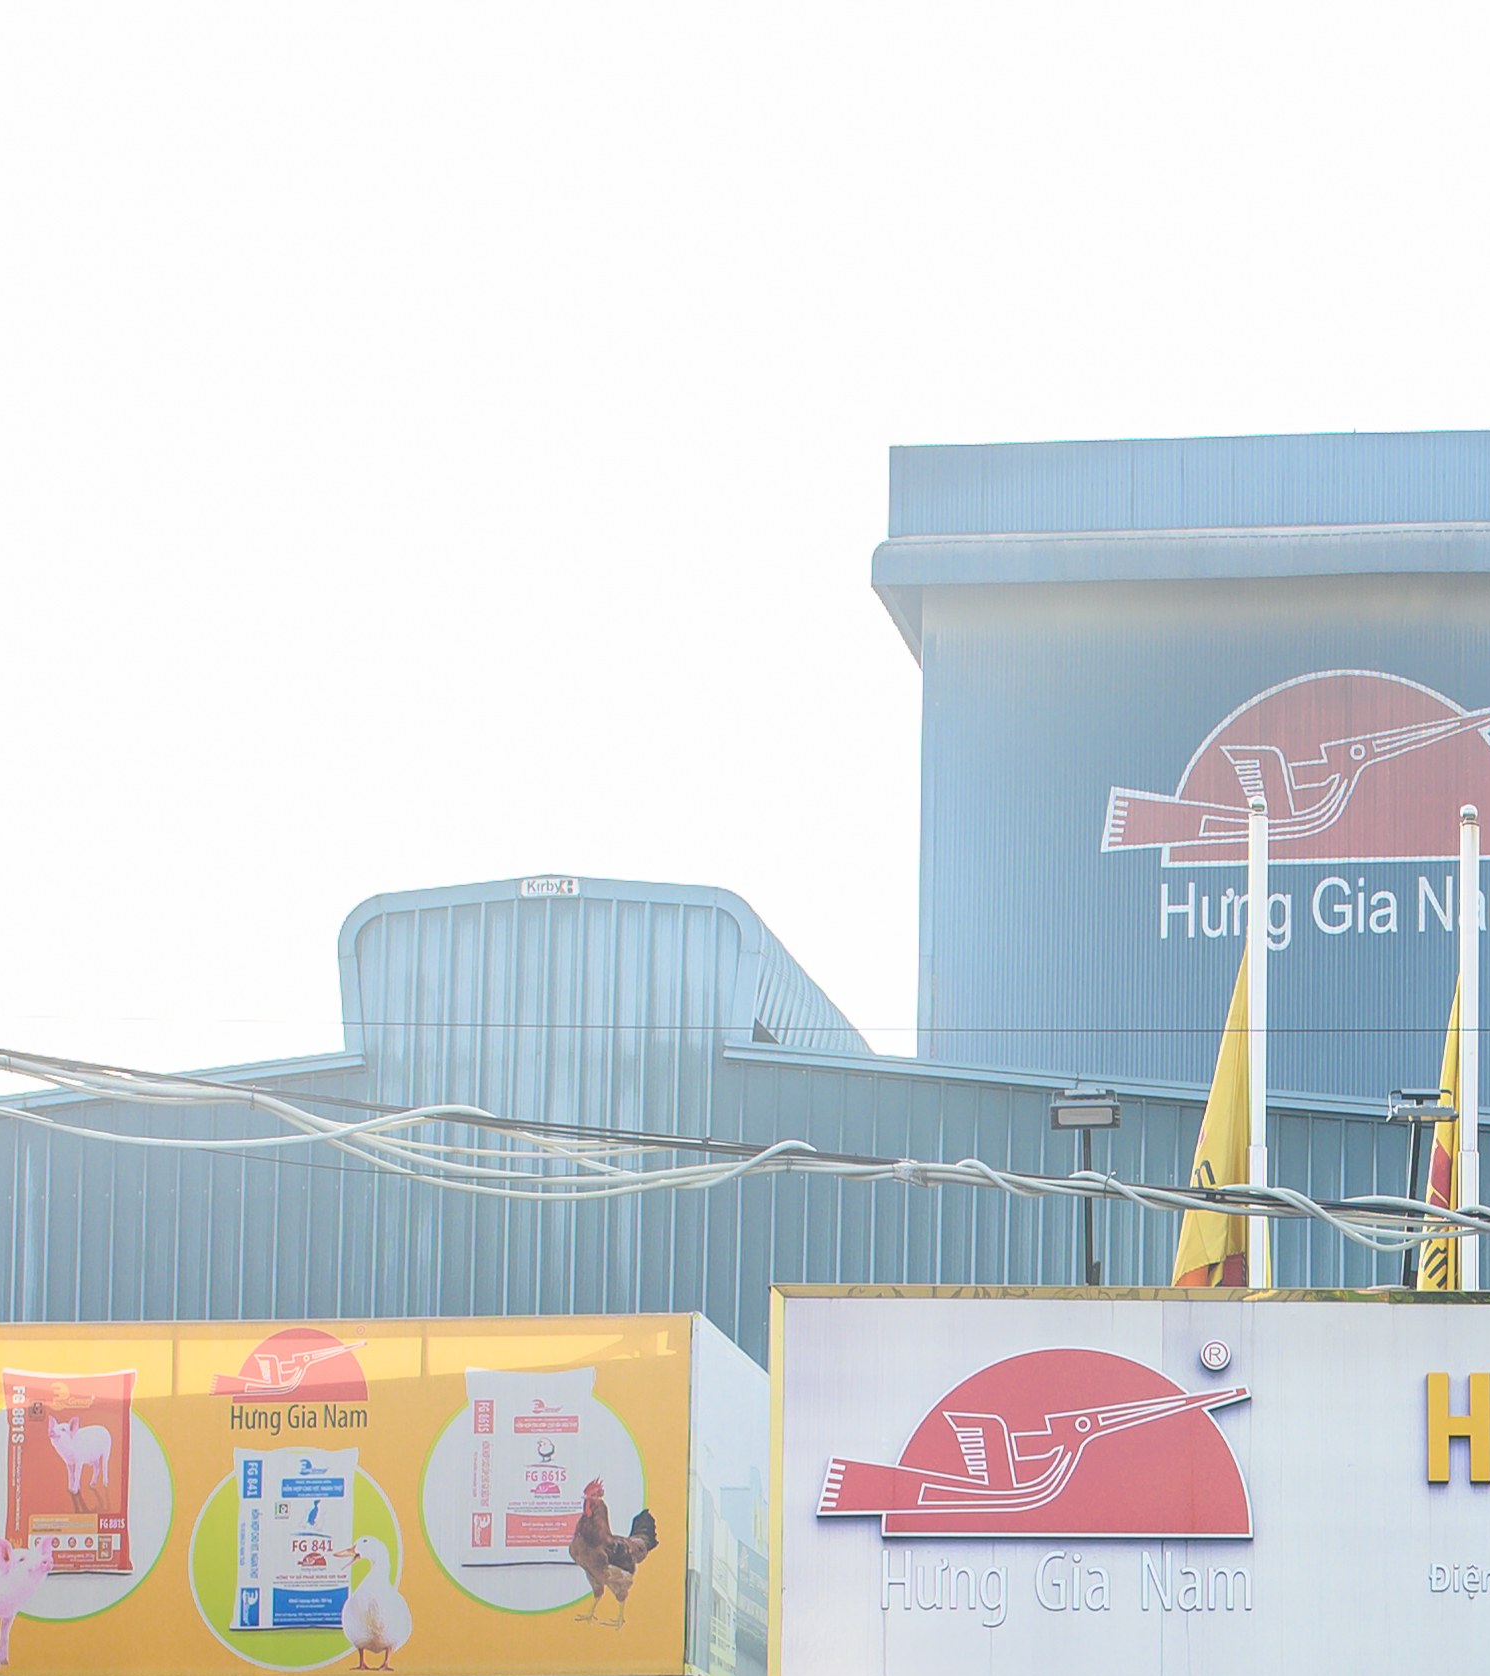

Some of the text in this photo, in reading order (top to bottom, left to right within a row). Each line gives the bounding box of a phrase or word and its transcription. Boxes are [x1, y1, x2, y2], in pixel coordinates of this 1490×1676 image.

[1160, 881, 1292, 951] Hưng
[1313, 876, 1397, 934] Gia
[12, 1385, 25, 1405] FG
[478, 1402, 490, 1414] FG
[12, 1408, 25, 1444] 881S
[230, 1404, 368, 1436] Hưng Gia Nam
[247, 1462, 258, 1496] FG 841
[525, 1470, 567, 1481] FG 861S
[292, 1540, 333, 1552] FG 841
[881, 1551, 1252, 1626] Hưng Gia Nam
